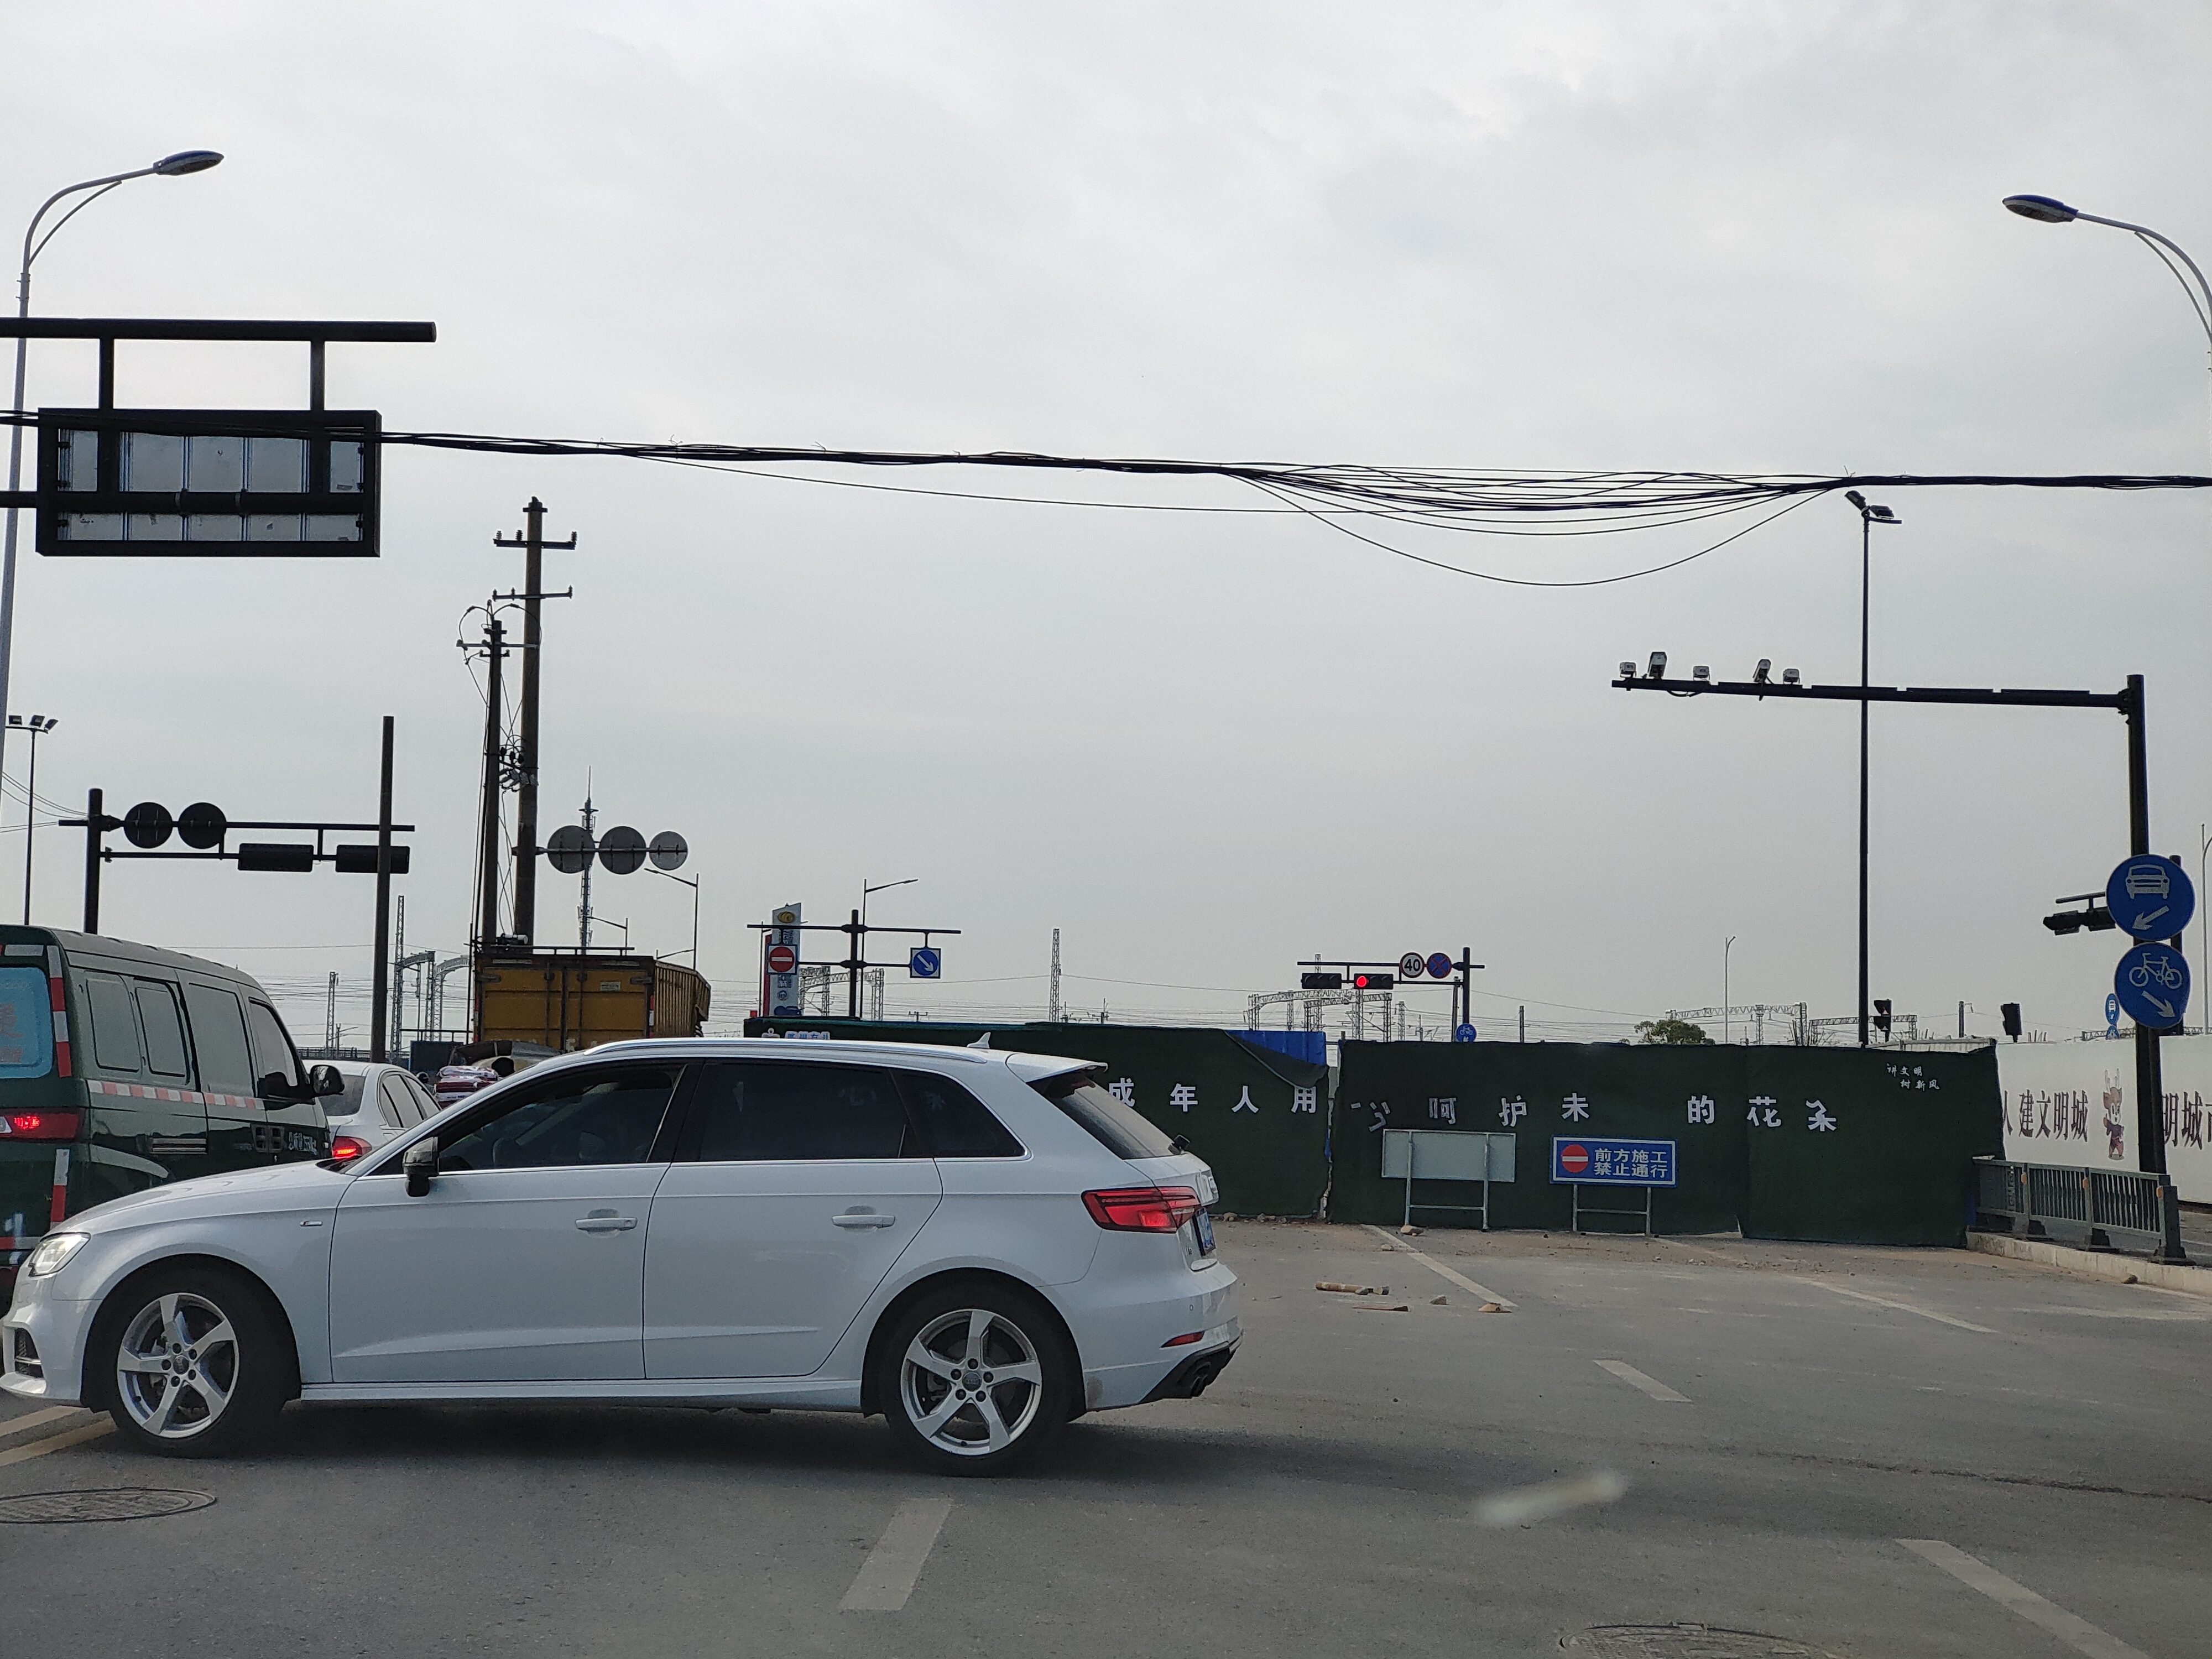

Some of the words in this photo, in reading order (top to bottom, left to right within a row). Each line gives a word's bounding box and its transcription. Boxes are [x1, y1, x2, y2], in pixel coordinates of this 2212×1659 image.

[1404, 959, 1421, 972] 40
[1886, 1063, 1922, 1077] 讲文明
[1900, 1079, 1940, 1092] 树新风
[1108, 1077, 1317, 1113] 成年人用
[1594, 1147, 1668, 1164] 前方施工
[1594, 1162, 1668, 1178] 禁止通行
